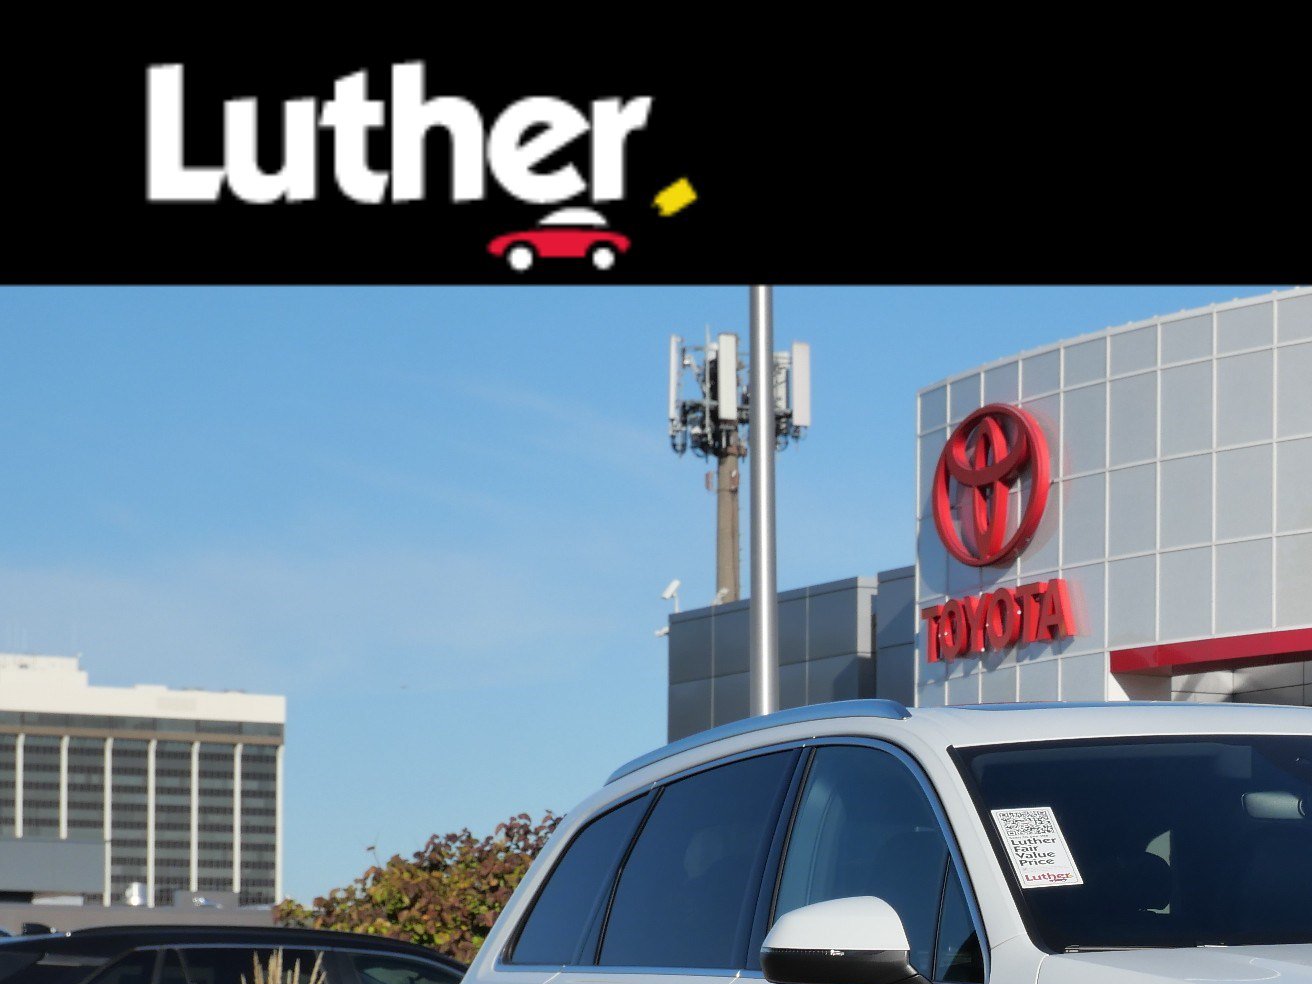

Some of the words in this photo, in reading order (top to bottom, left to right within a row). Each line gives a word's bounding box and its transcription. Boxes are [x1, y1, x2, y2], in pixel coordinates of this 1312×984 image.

[921, 578, 1077, 663] TOYOTA
[1011, 837, 1056, 846] Luther
[1015, 851, 1056, 859] Value
[1025, 872, 1071, 881] Luther
